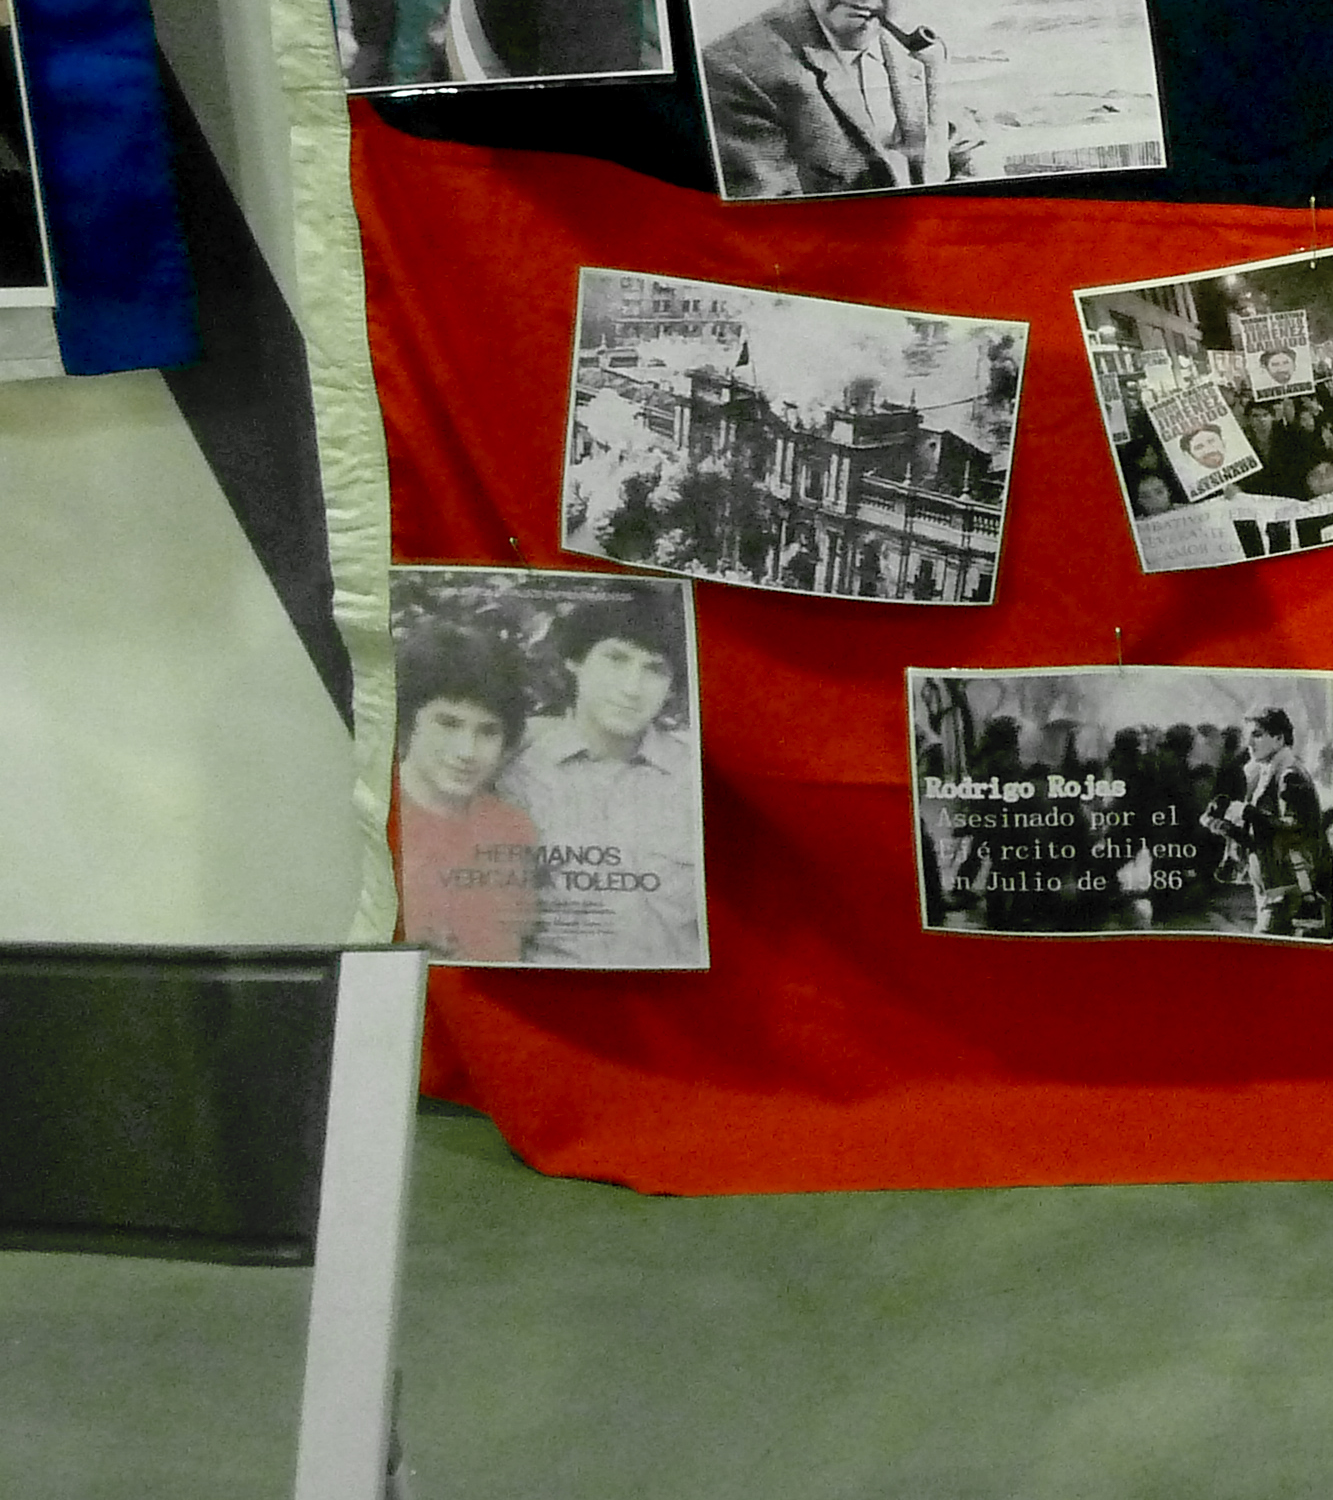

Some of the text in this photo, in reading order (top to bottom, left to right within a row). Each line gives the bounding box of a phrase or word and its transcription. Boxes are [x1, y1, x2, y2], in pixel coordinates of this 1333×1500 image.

[924, 773, 1128, 803] Rodrigo Rojas
[937, 804, 1180, 831] Asesinado por el
[1091, 836, 1198, 860] chileno
[560, 869, 662, 893] TOLEDO
[986, 870, 1062, 892] Julio
[1076, 870, 1107, 891] de
